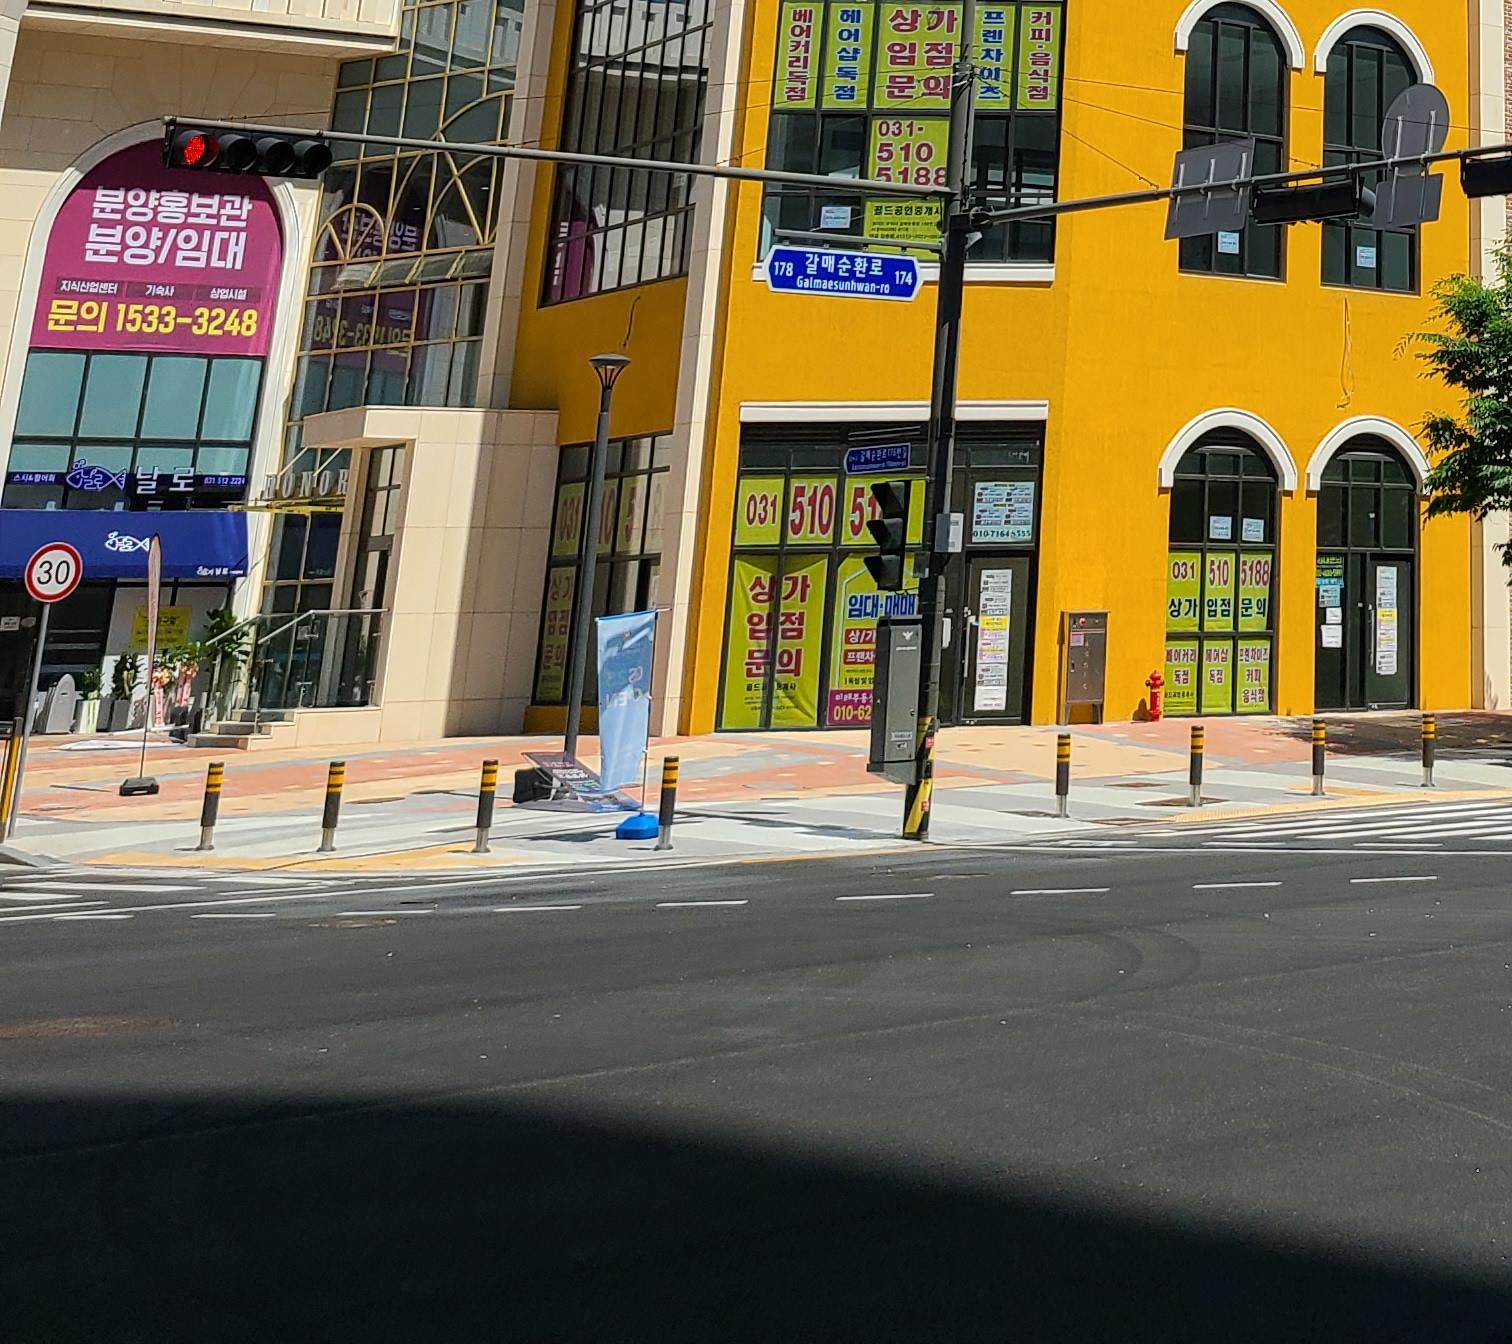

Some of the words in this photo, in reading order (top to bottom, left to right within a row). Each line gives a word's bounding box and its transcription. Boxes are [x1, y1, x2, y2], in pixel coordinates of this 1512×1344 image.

[888, 7, 958, 34] 상가
[886, 41, 954, 67] 입점
[978, 9, 1006, 100] 프렌차이즈
[885, 74, 951, 100] 문의
[878, 120, 924, 137] 031-
[876, 142, 934, 163] 510
[875, 166, 947, 186] 5188
[91, 185, 253, 228] 분양홍보관
[84, 223, 248, 270] 분양/임대
[773, 261, 794, 277] 178
[804, 252, 884, 278] 갈매순환로
[59, 279, 118, 295] 지식산업센터
[145, 284, 175, 297] 기숙사
[209, 287, 248, 301] 상업시설
[796, 275, 891, 294] Galmaesunhwan-ro
[894, 270, 913, 286] 174
[47, 298, 109, 333] 문의
[115, 302, 258, 337] 1533-3248
[745, 492, 779, 527] 031
[788, 480, 835, 538] 510
[36, 560, 71, 585] 30
[1172, 561, 1195, 580] 031
[1209, 559, 1229, 587] 510
[1240, 559, 1270, 587] 5188
[749, 574, 811, 604] 상가
[1168, 597, 1198, 619] 상가
[1206, 597, 1231, 618] 입점
[1240, 597, 1267, 618] 문의
[746, 610, 805, 641] 입점
[744, 648, 804, 679] 문의
[1246, 668, 1262, 683] 커피
[1174, 669, 1189, 685] 독점
[1208, 669, 1224, 684] 독점
[1242, 688, 1265, 704] 음식점
